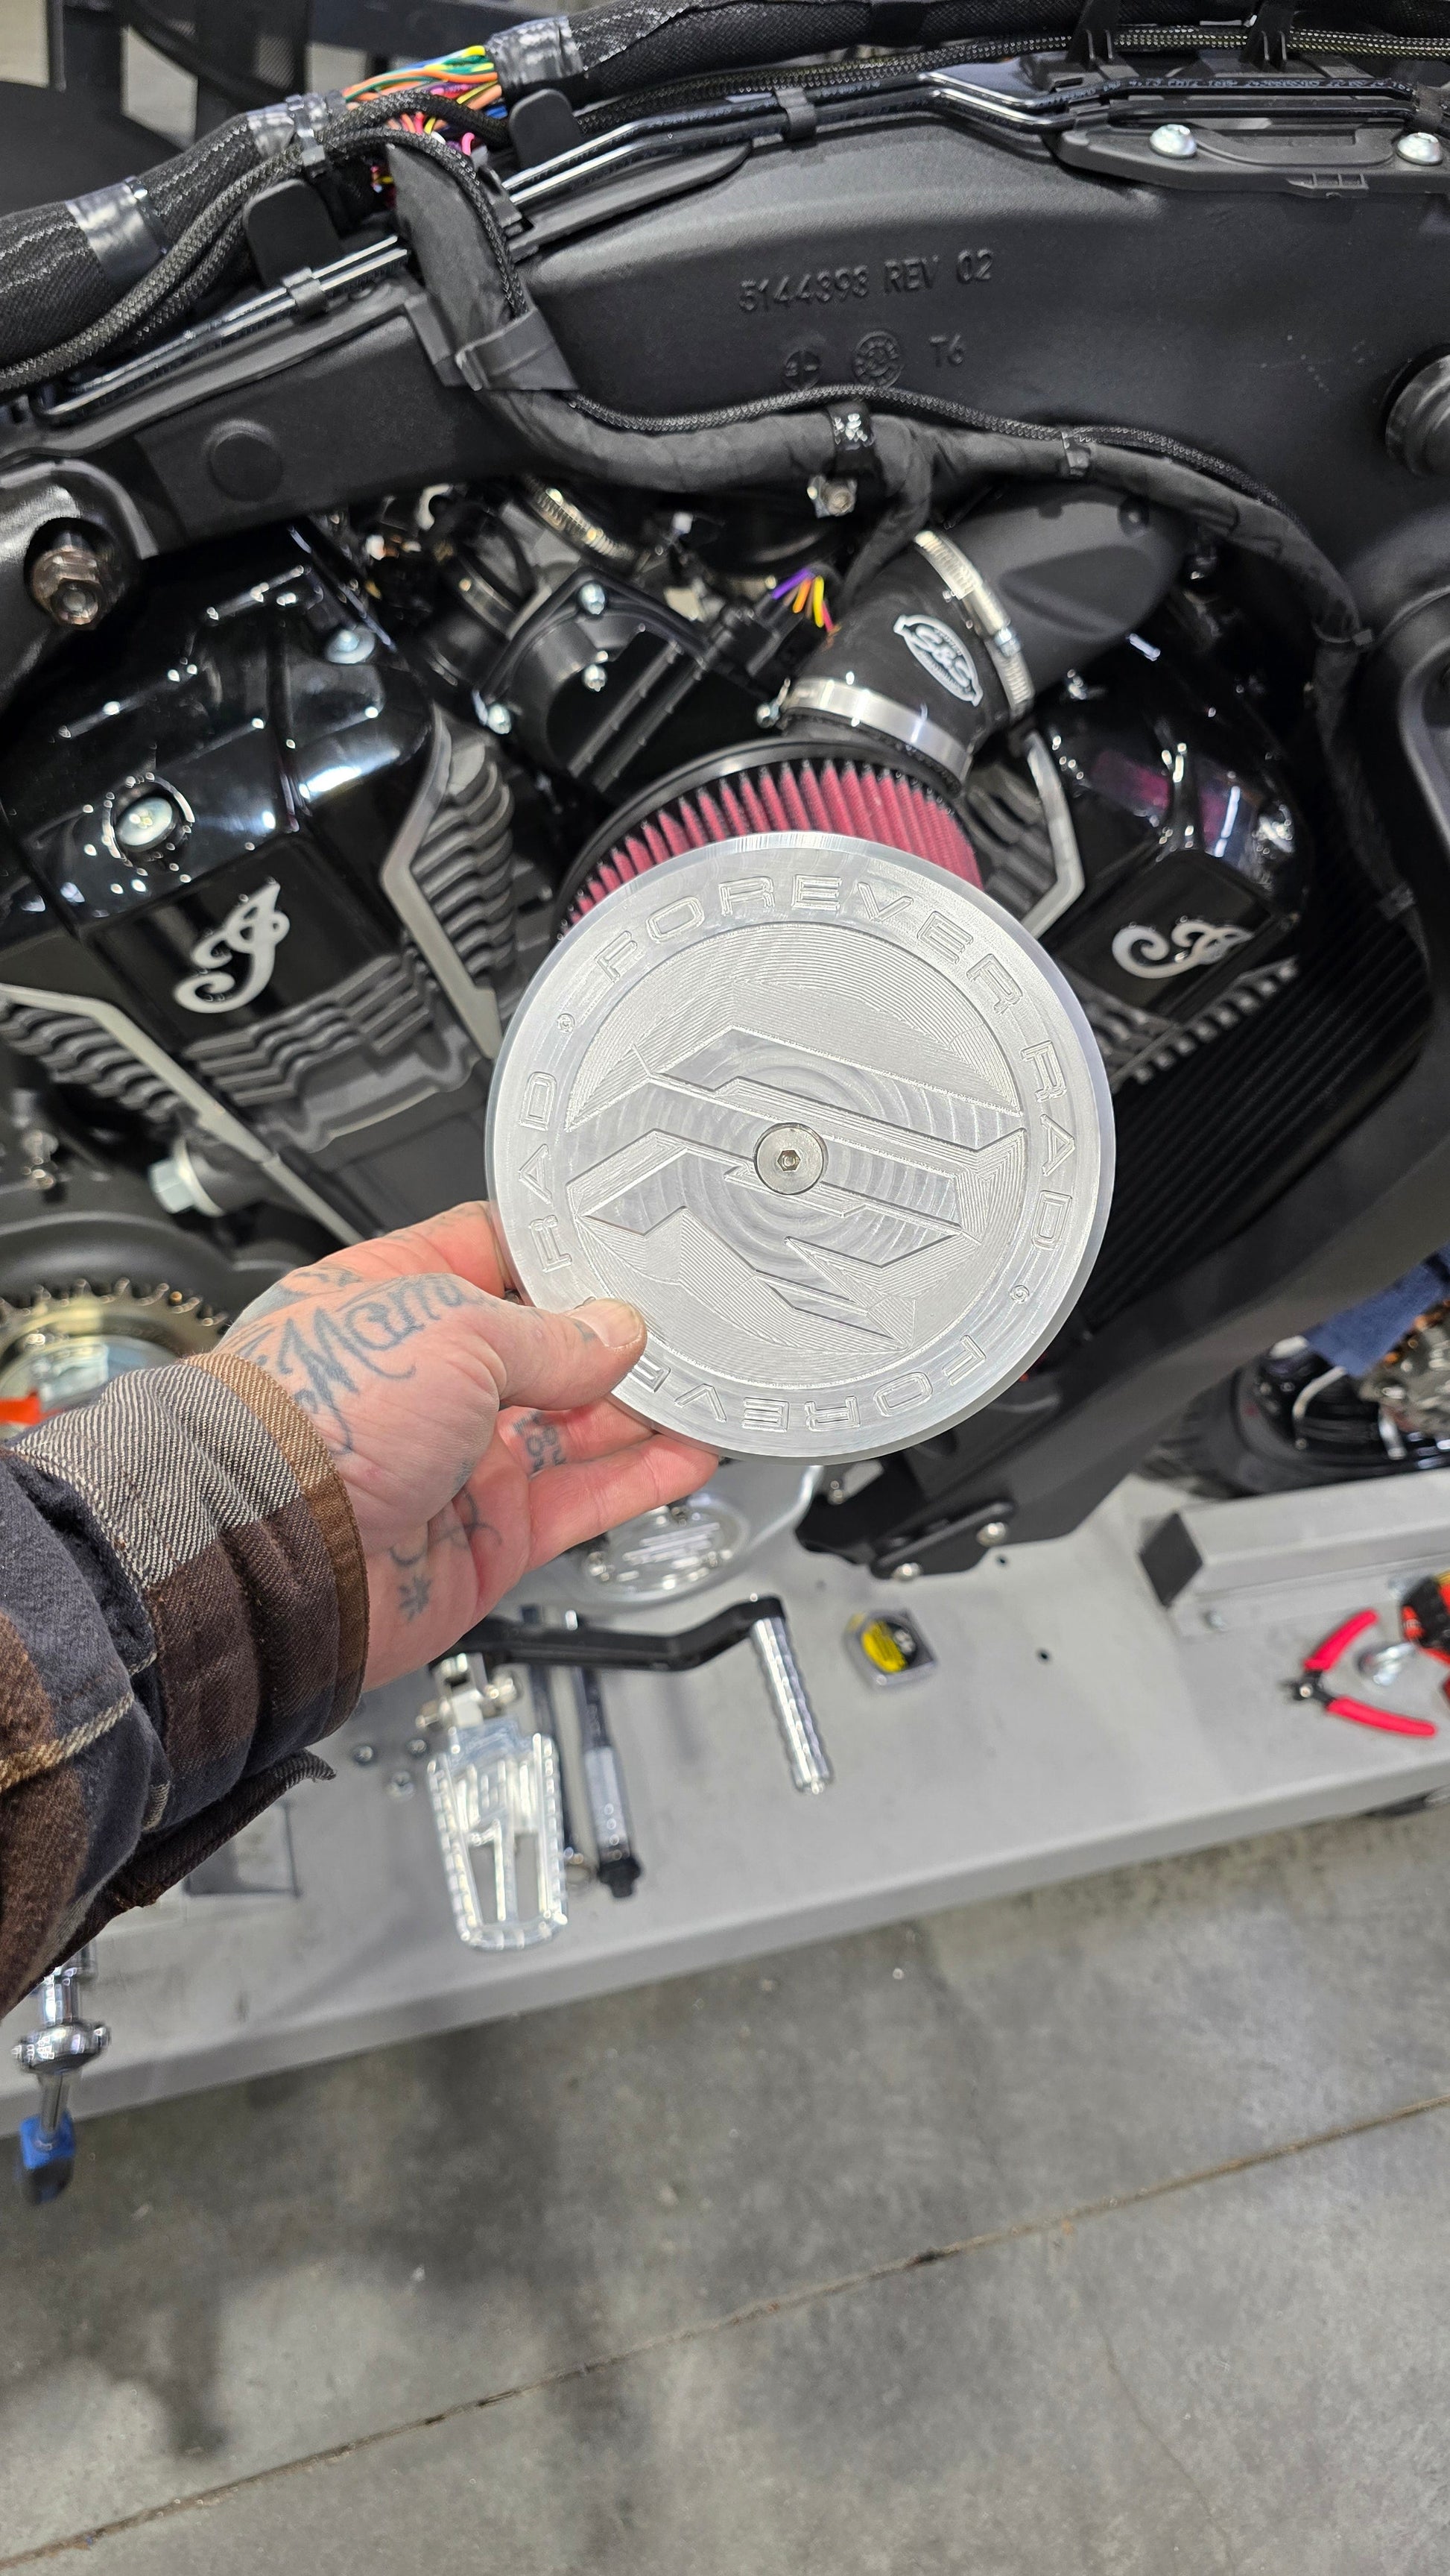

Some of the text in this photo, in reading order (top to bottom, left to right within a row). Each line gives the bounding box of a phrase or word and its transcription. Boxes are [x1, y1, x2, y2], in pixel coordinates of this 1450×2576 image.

[884, 254, 940, 293] REV
[956, 248, 994, 285] 02
[594, 874, 1075, 1250] FOREVER RAD
[518, 1071, 987, 1433] FOREVE RAD
